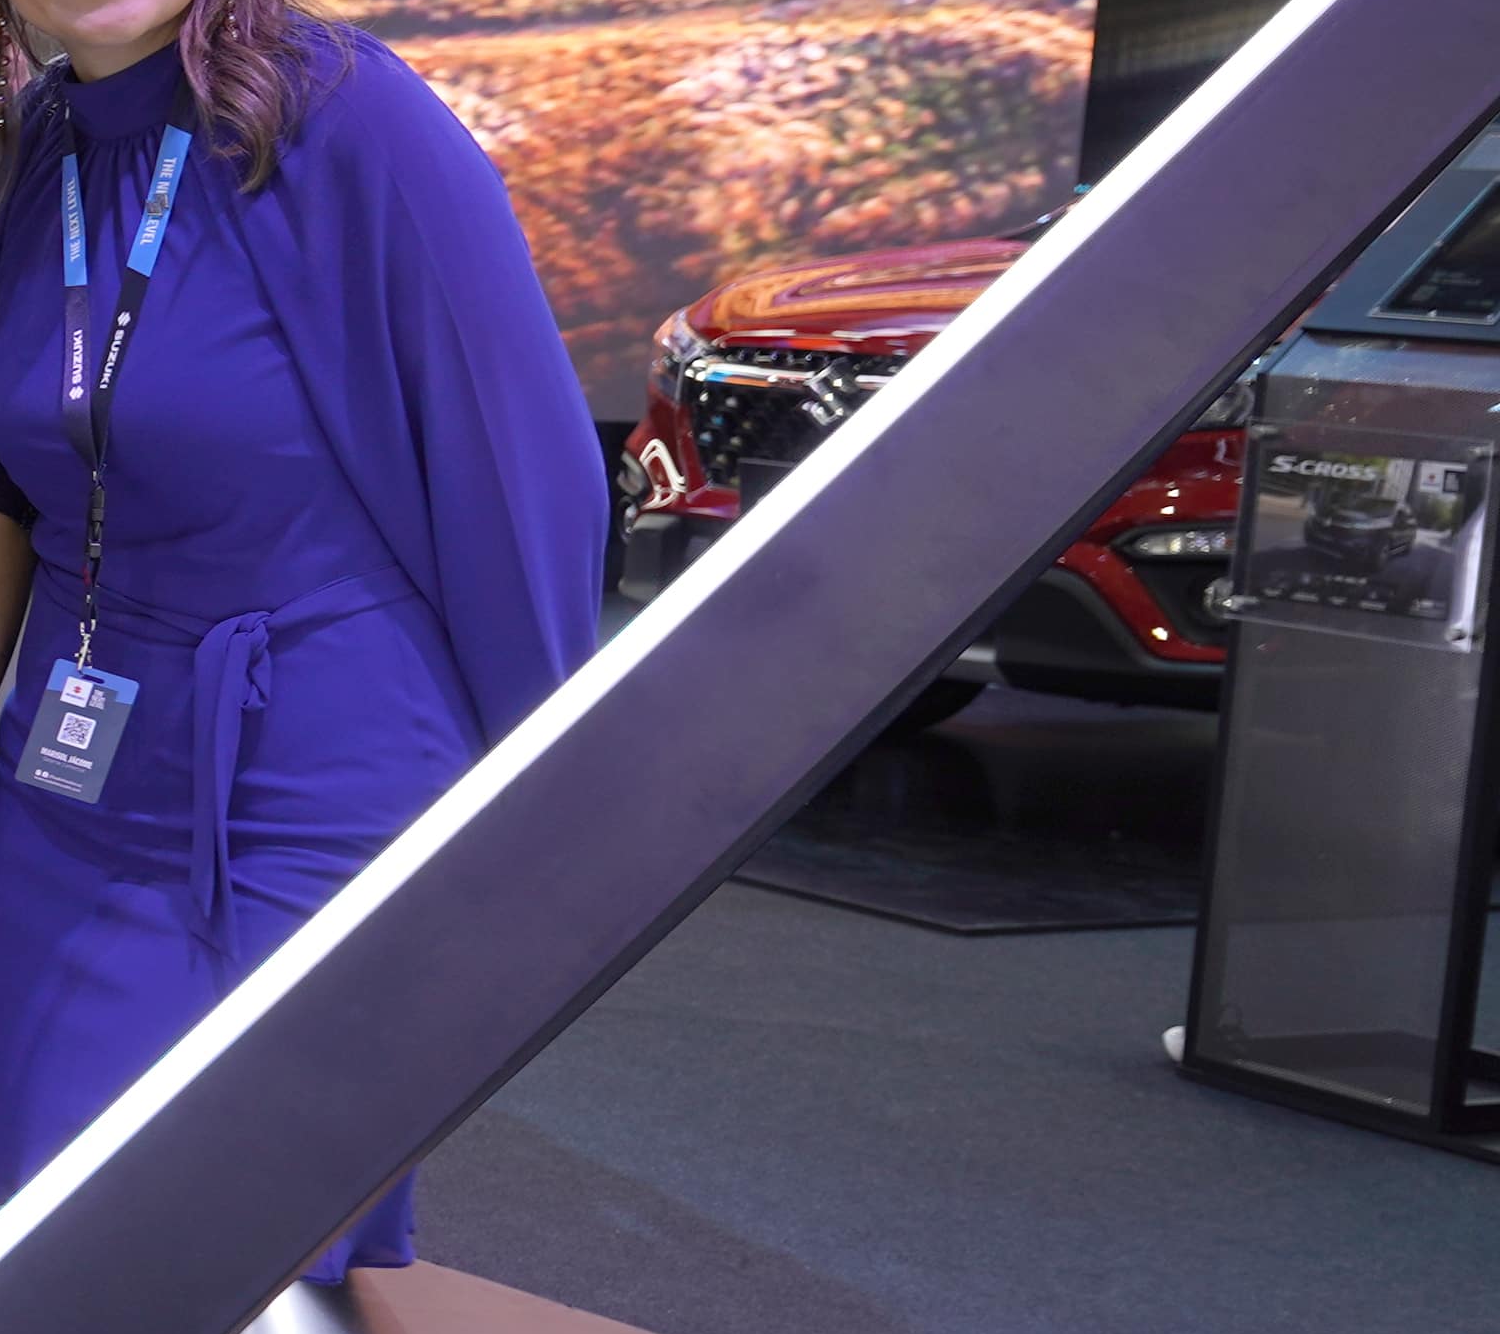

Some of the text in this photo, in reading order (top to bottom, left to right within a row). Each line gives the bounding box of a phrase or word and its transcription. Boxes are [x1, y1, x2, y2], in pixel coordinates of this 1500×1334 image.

[160, 157, 177, 179] THE
[68, 211, 80, 240] NEXT
[140, 218, 160, 245] EVEL
[69, 238, 80, 263] THE
[72, 329, 83, 387] SUZUKI
[100, 329, 125, 390] SUZUKI
[1269, 455, 1378, 482] S-CROSS
